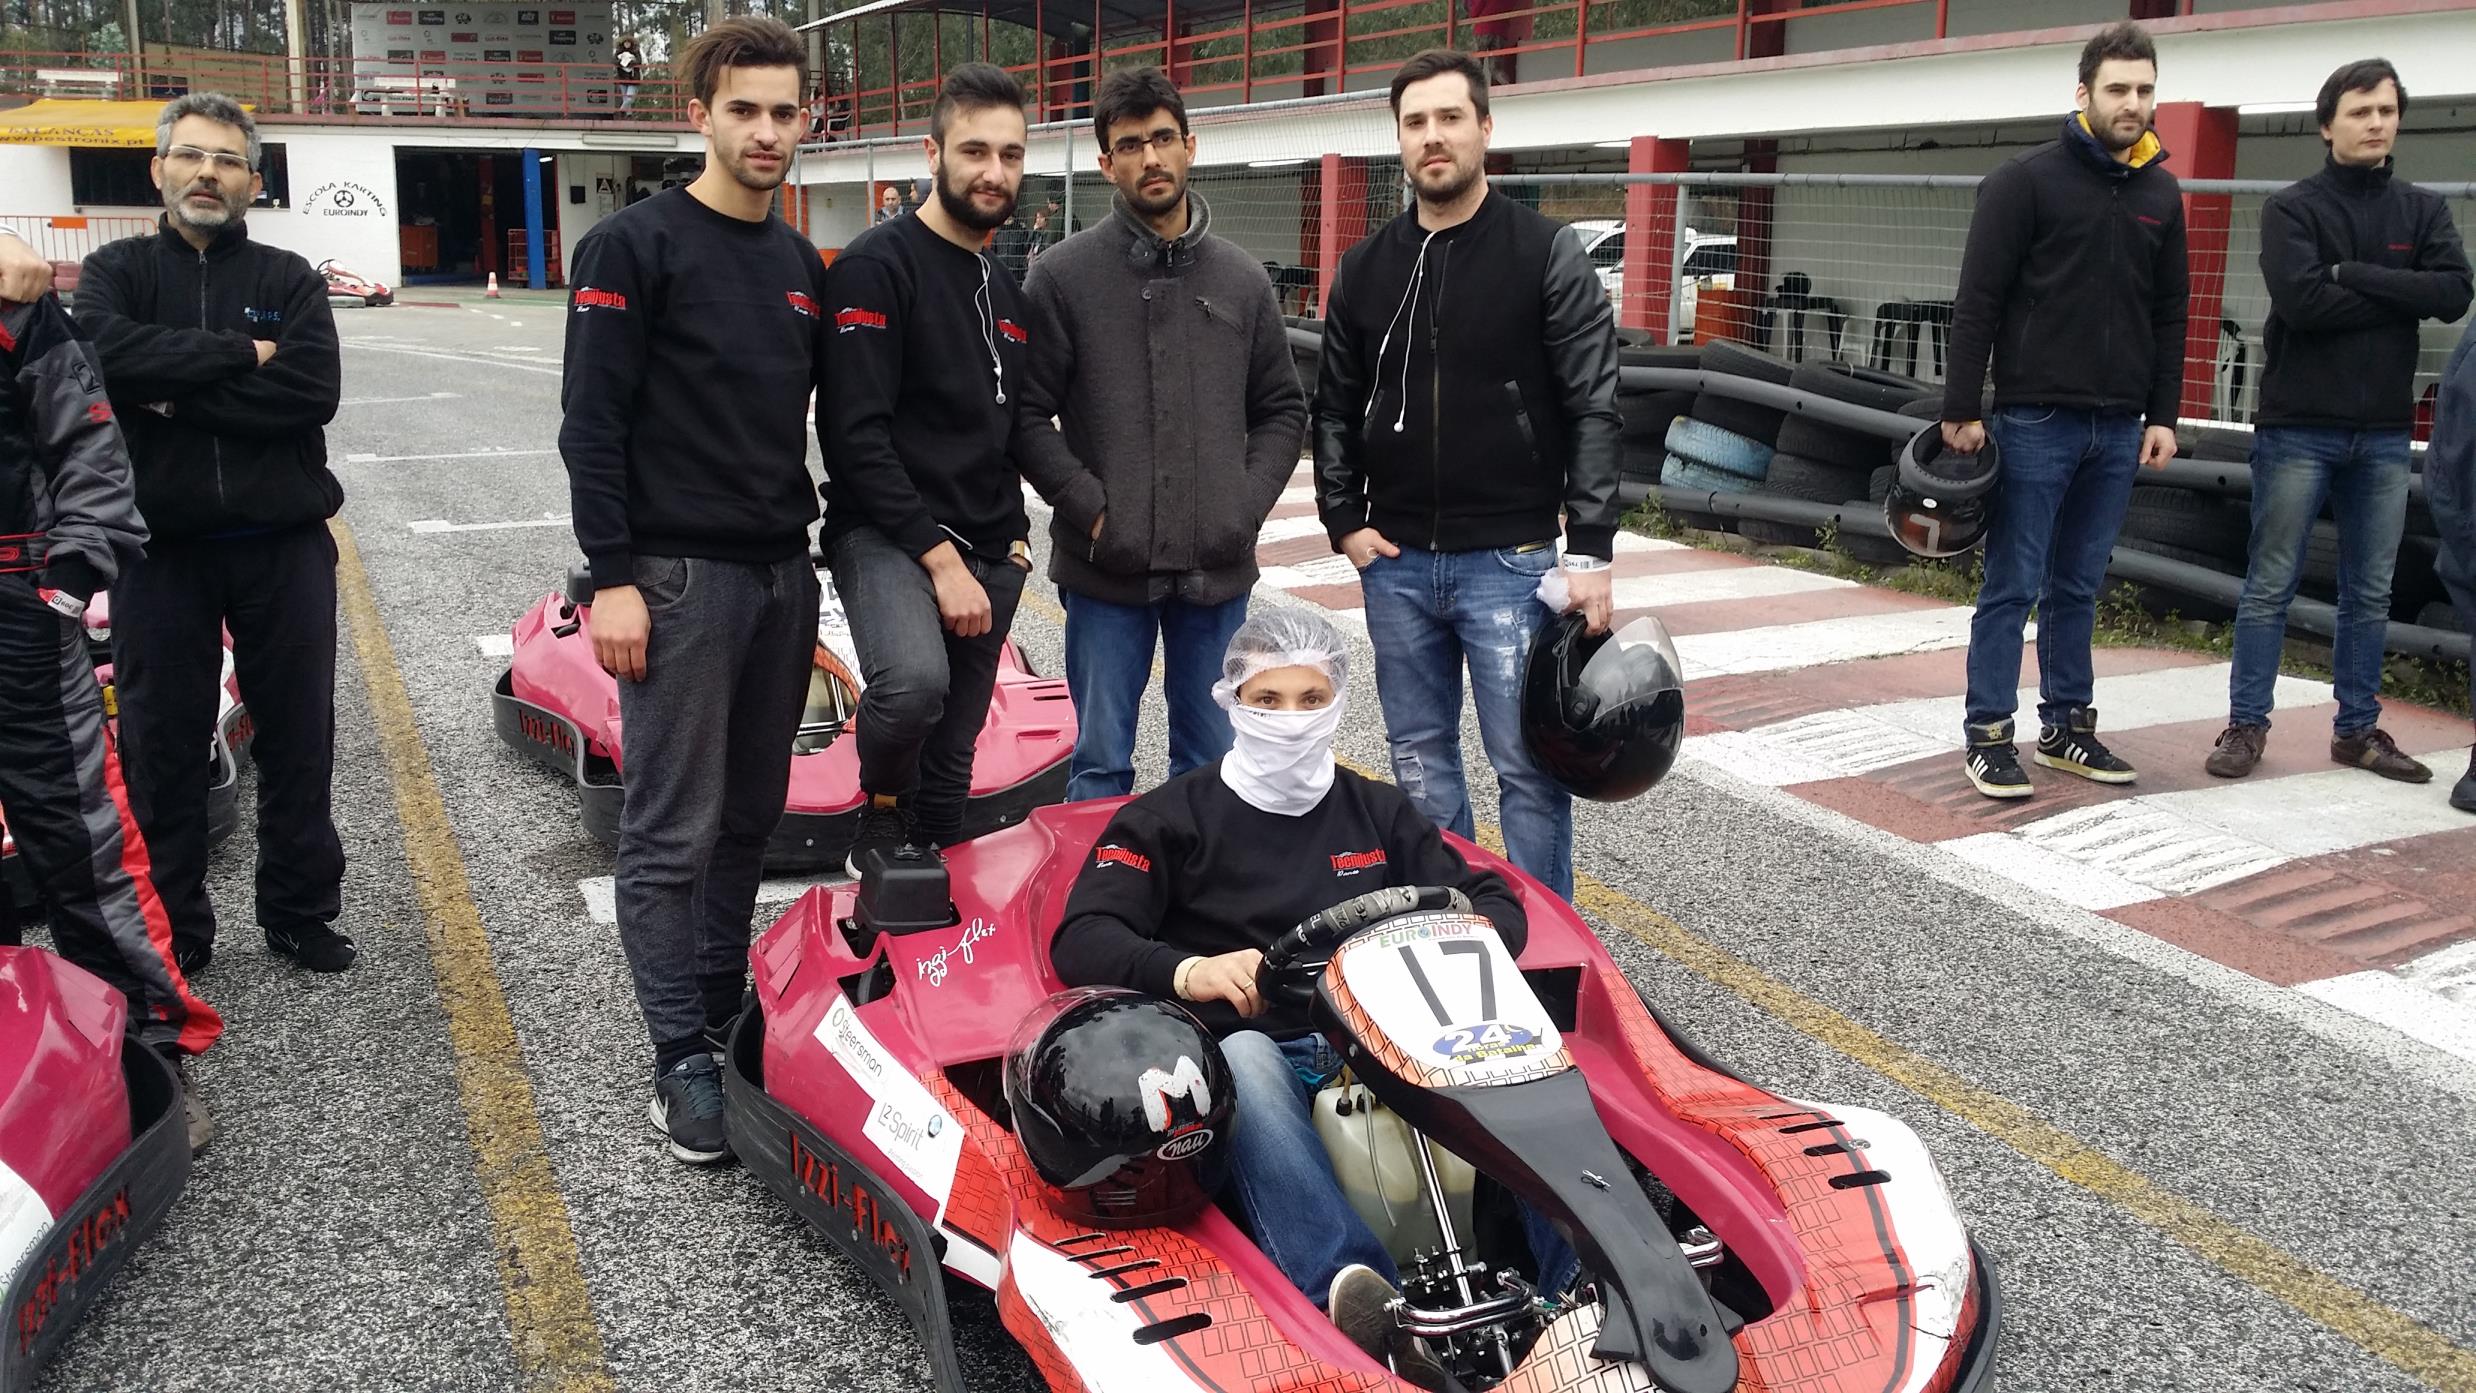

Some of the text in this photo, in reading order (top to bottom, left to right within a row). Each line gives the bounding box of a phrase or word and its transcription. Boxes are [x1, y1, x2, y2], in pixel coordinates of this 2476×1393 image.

[303, 181, 387, 217] ESCOLA KARTING
[323, 208, 369, 217] EUROINDY
[1398, 940, 1498, 1028] 17
[839, 1019, 883, 1078] Steersman
[1138, 1055, 1212, 1133] M
